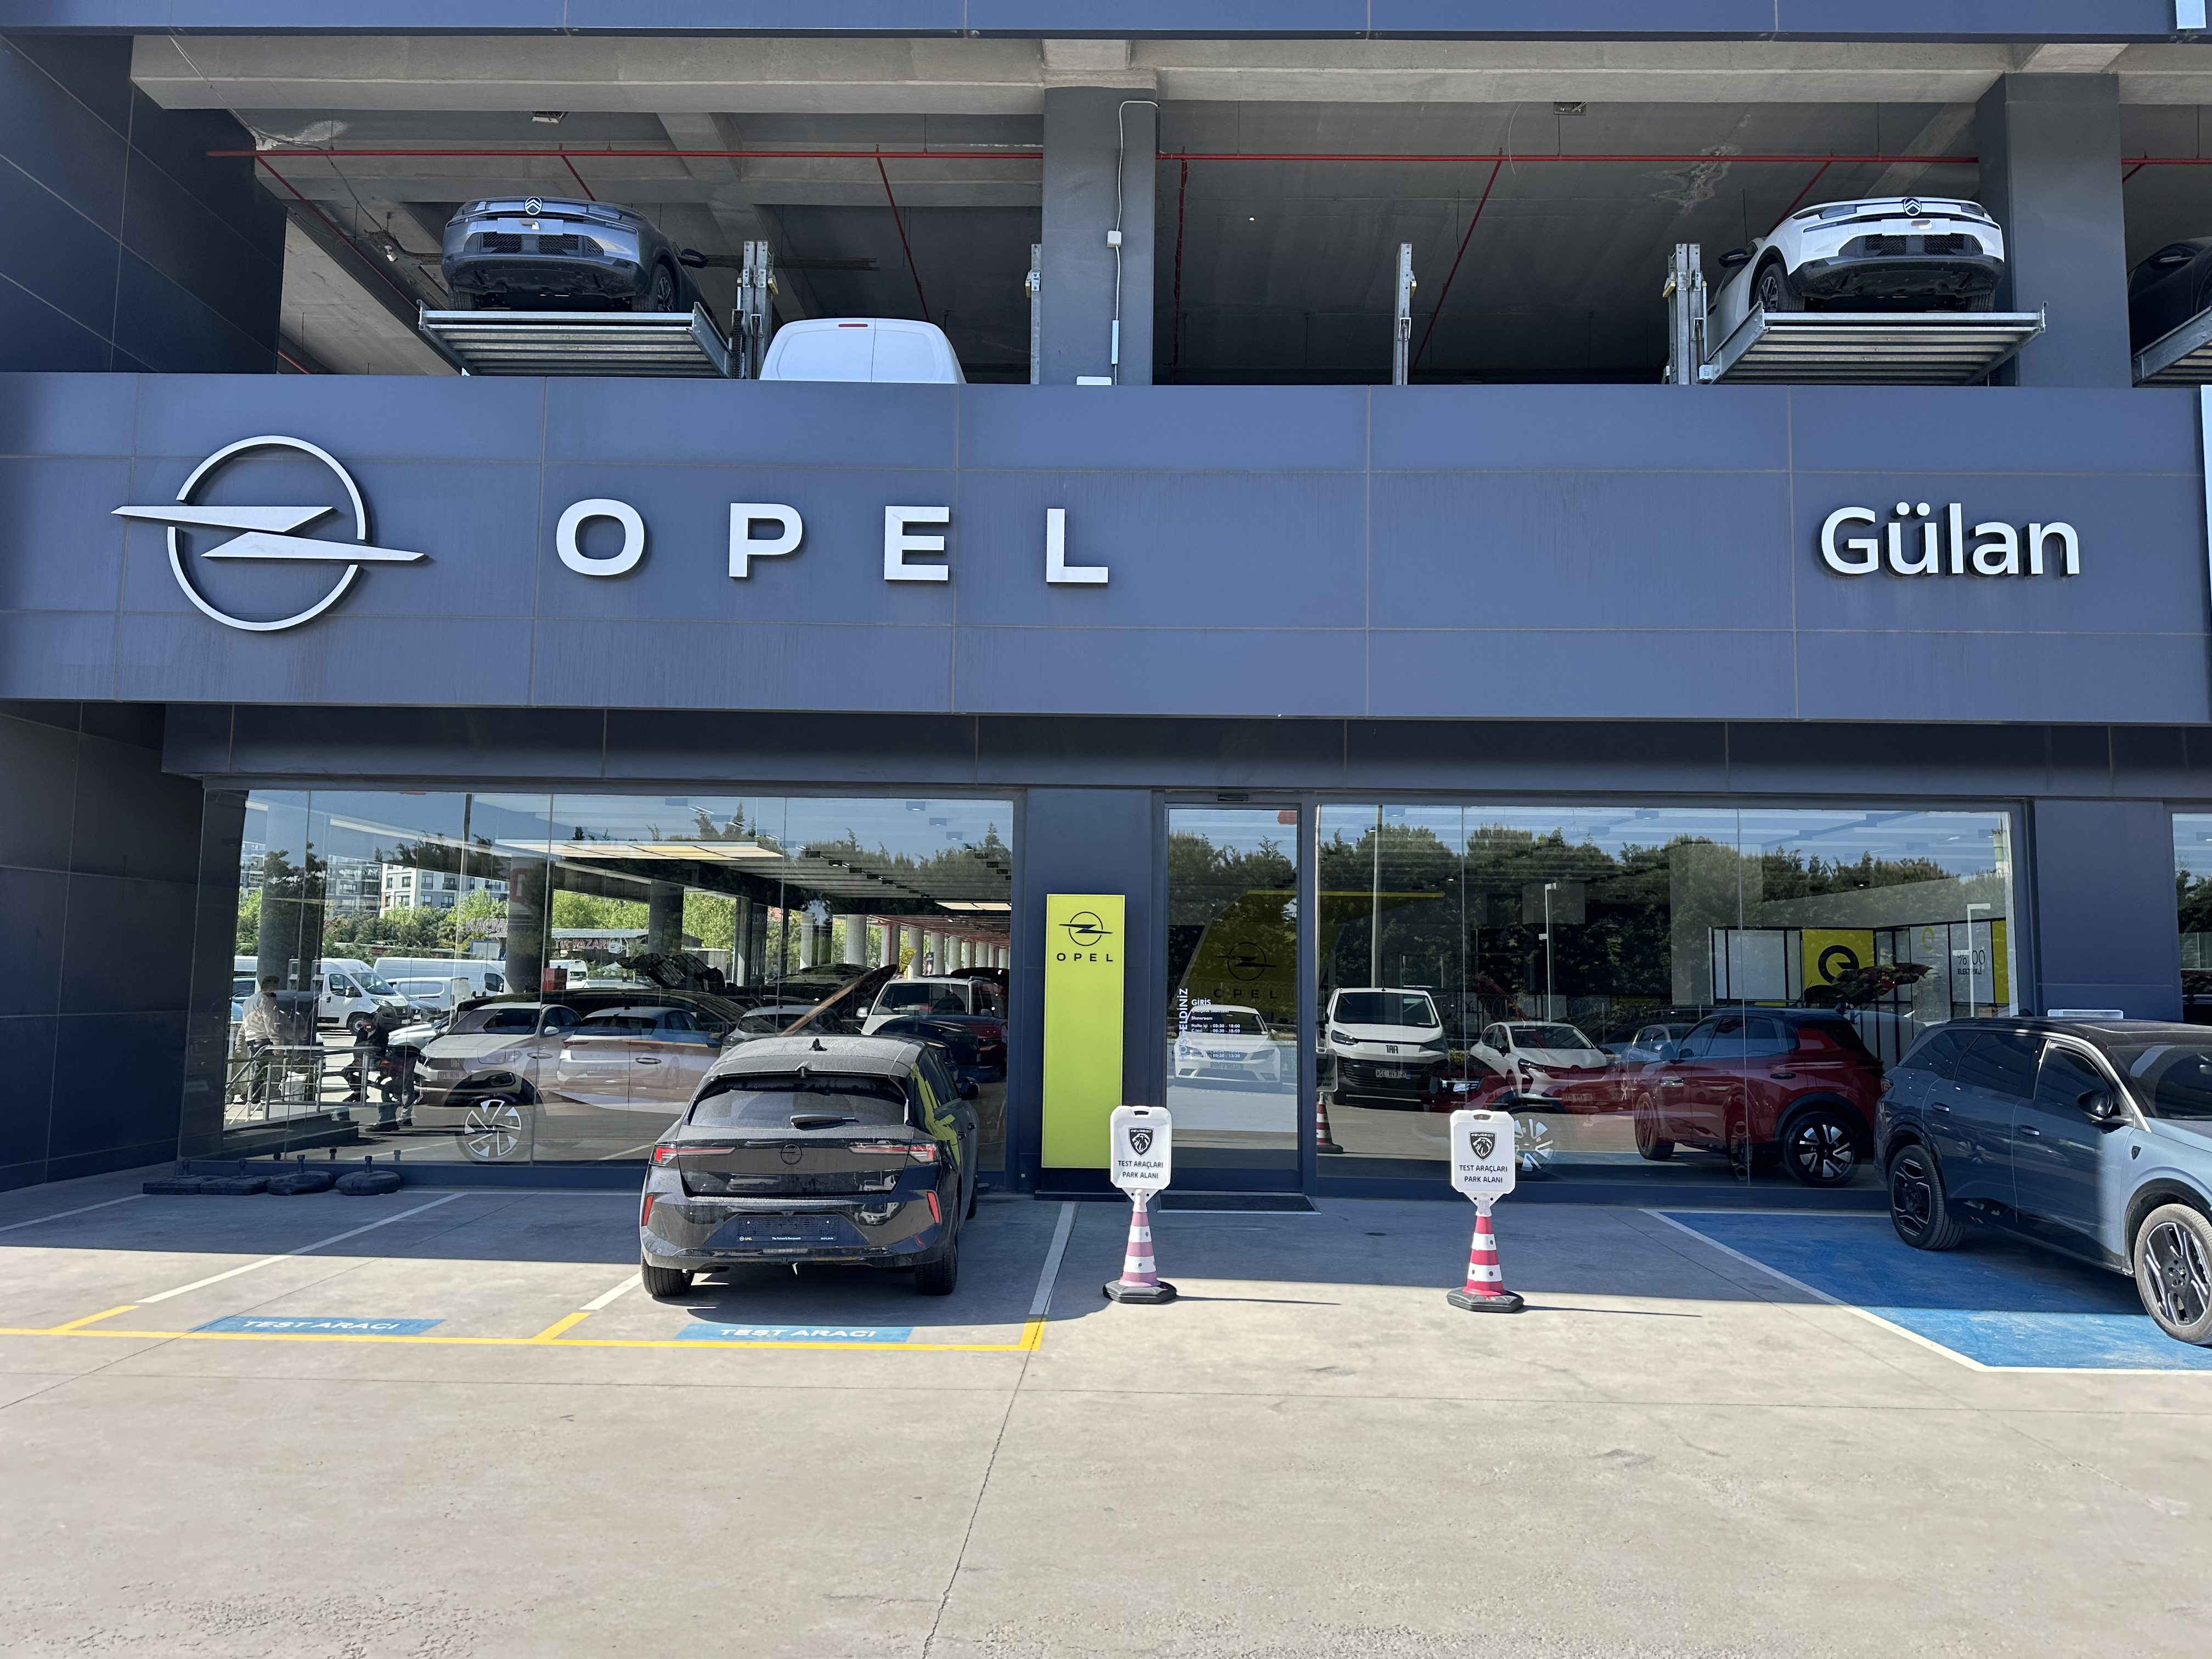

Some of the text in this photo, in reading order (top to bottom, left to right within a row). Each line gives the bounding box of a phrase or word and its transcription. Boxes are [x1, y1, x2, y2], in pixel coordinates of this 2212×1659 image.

[556, 498, 1109, 583] OPEL
[1820, 501, 2081, 575] Gülan
[1056, 952, 1113, 962] OPEL
[1214, 988, 1278, 1000] OPEL
[1134, 1161, 1163, 1169] ARAÇLARI
[243, 1321, 311, 1329] TEST
